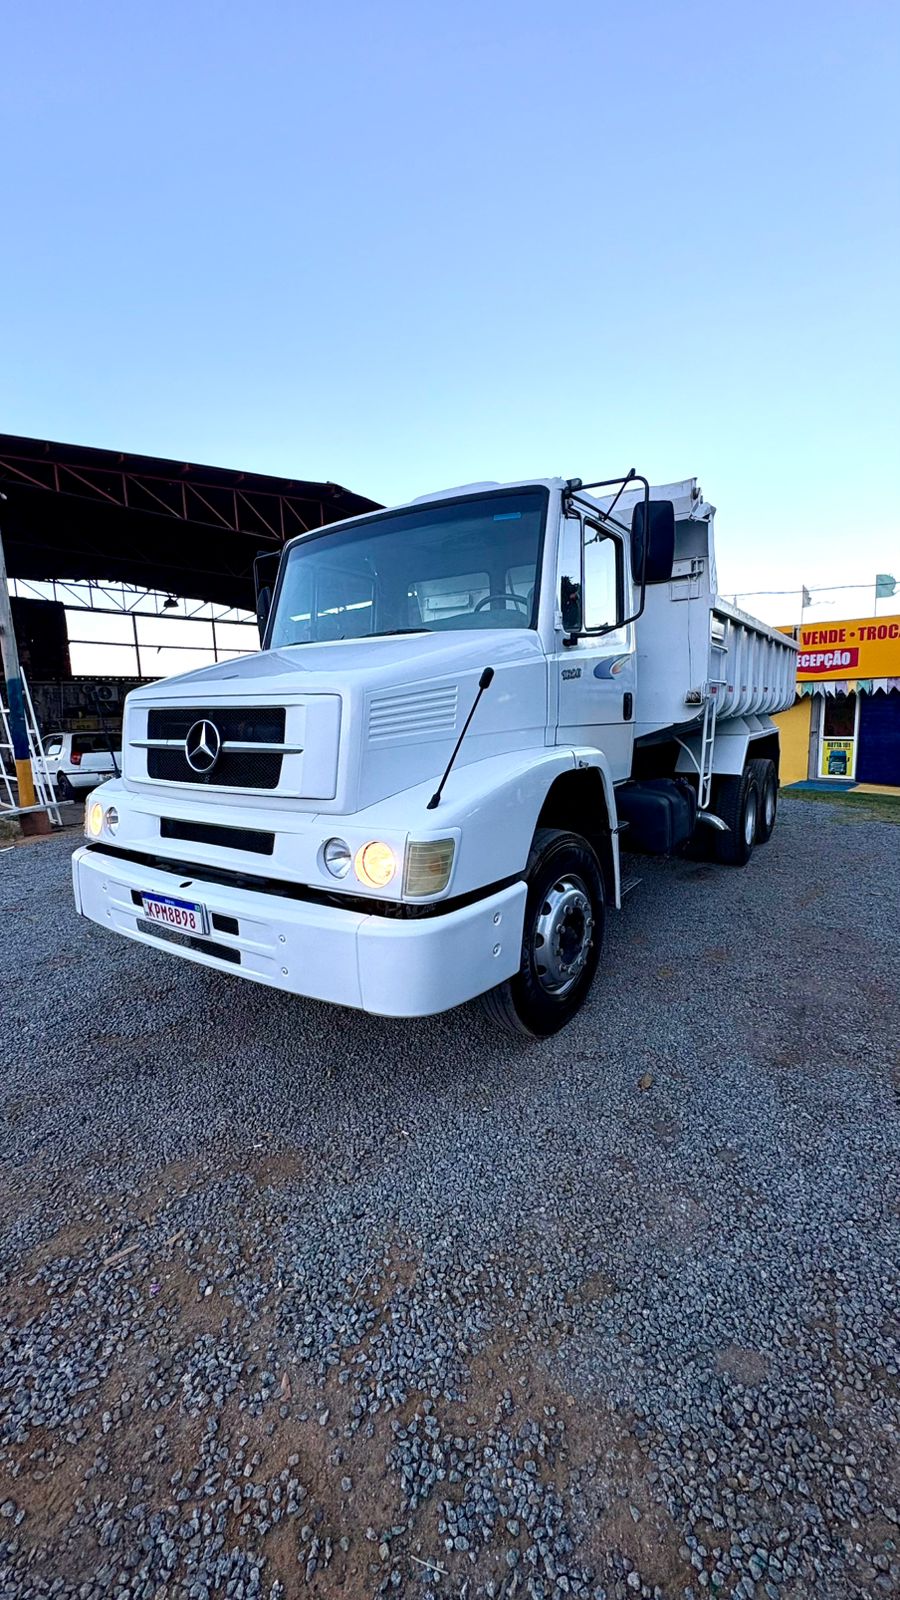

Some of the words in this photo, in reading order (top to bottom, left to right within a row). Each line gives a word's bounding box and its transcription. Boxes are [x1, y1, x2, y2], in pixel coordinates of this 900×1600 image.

[802, 628, 846, 646] VENDE
[858, 623, 900, 641] TROC
[147, 901, 196, 929] KPM8B98
